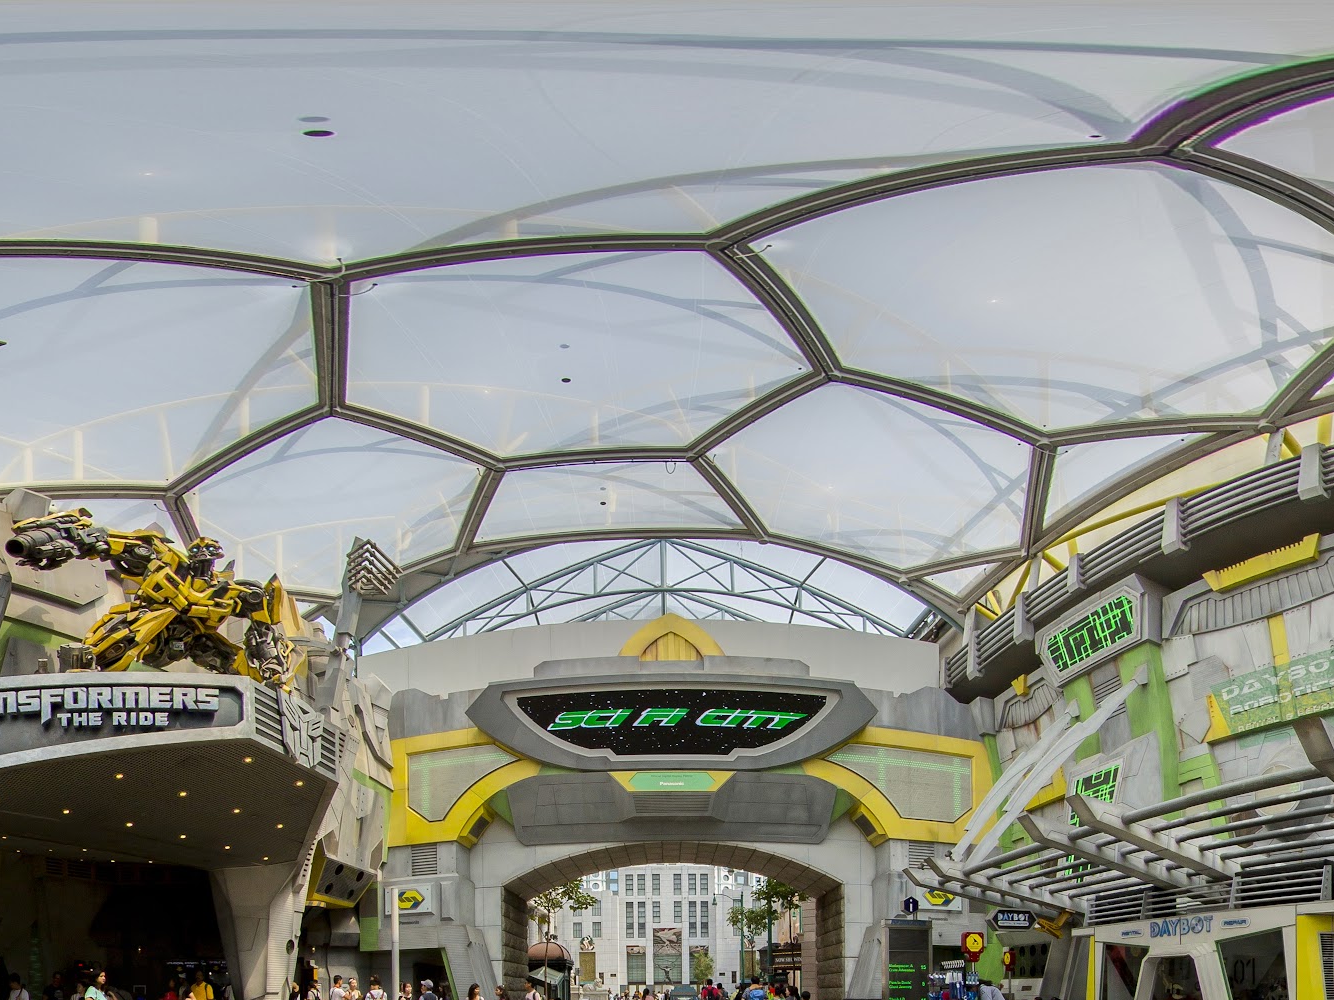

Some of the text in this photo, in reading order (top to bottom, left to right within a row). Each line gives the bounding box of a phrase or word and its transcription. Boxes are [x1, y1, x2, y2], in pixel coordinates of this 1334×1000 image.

[57, 711, 169, 727] THE RIDE
[547, 707, 808, 731] SCI FI CITY
[997, 912, 1030, 921] DAYBOT
[1149, 915, 1214, 938] DAYBOT
